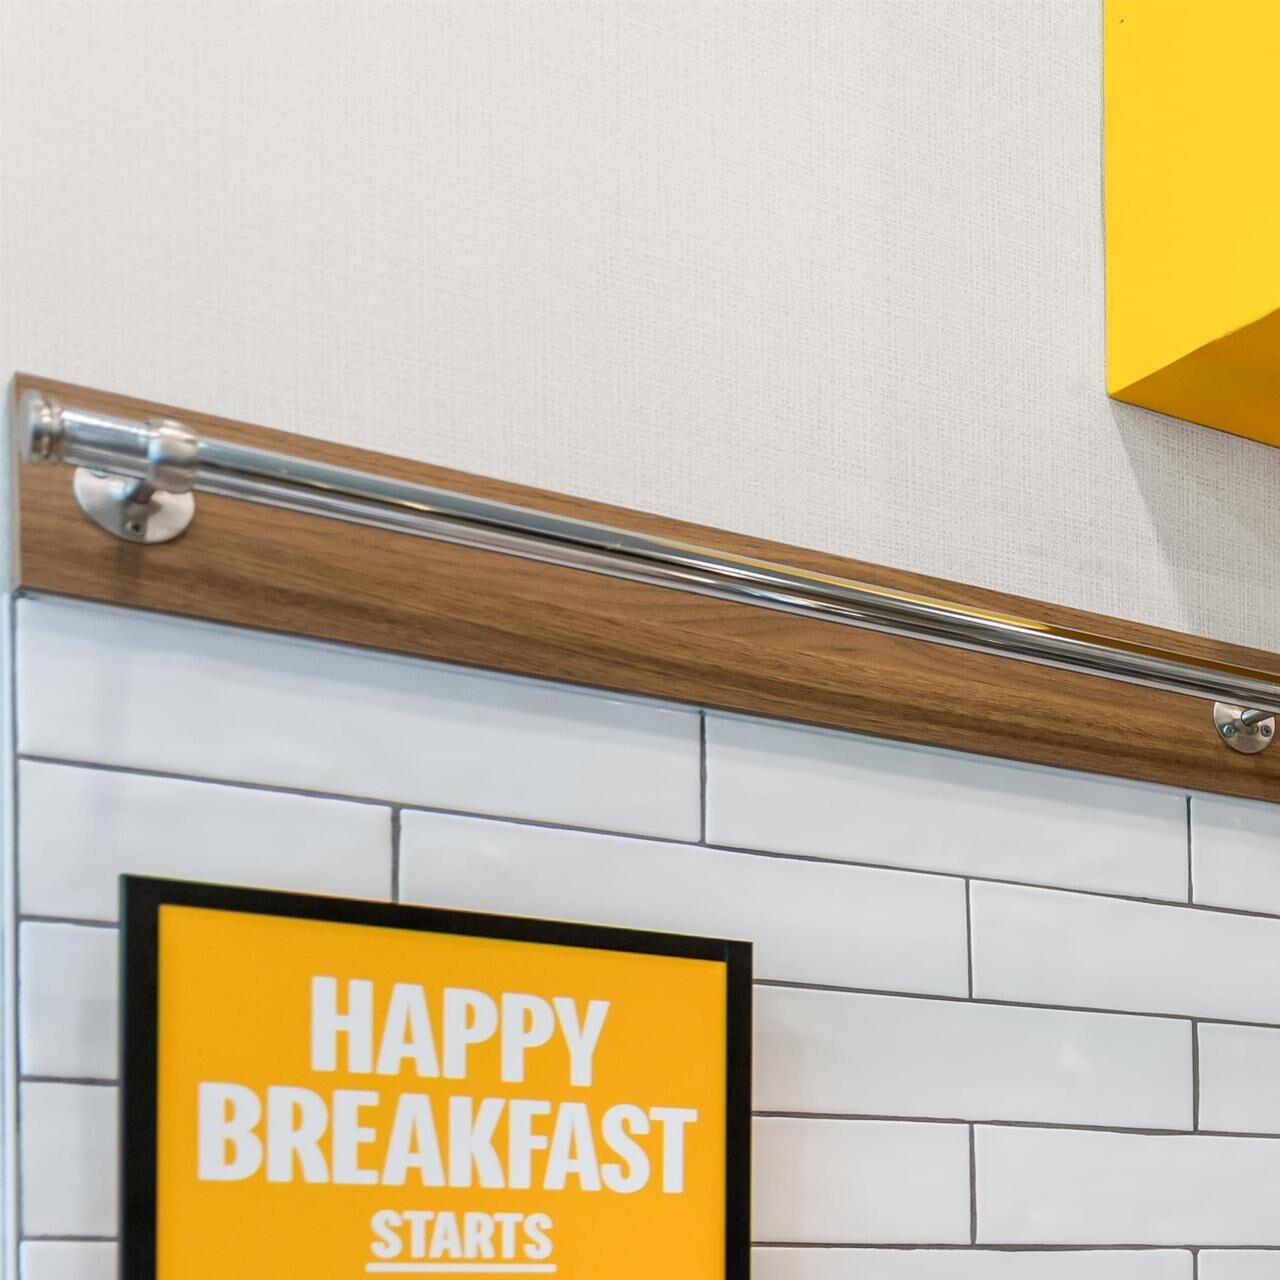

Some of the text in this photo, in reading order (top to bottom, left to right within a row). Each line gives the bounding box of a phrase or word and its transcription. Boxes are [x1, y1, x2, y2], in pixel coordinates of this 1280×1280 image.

[309, 975, 610, 1087] HAPPY
[197, 1081, 698, 1194] BREAKFAST
[369, 1209, 553, 1260] STARTS
